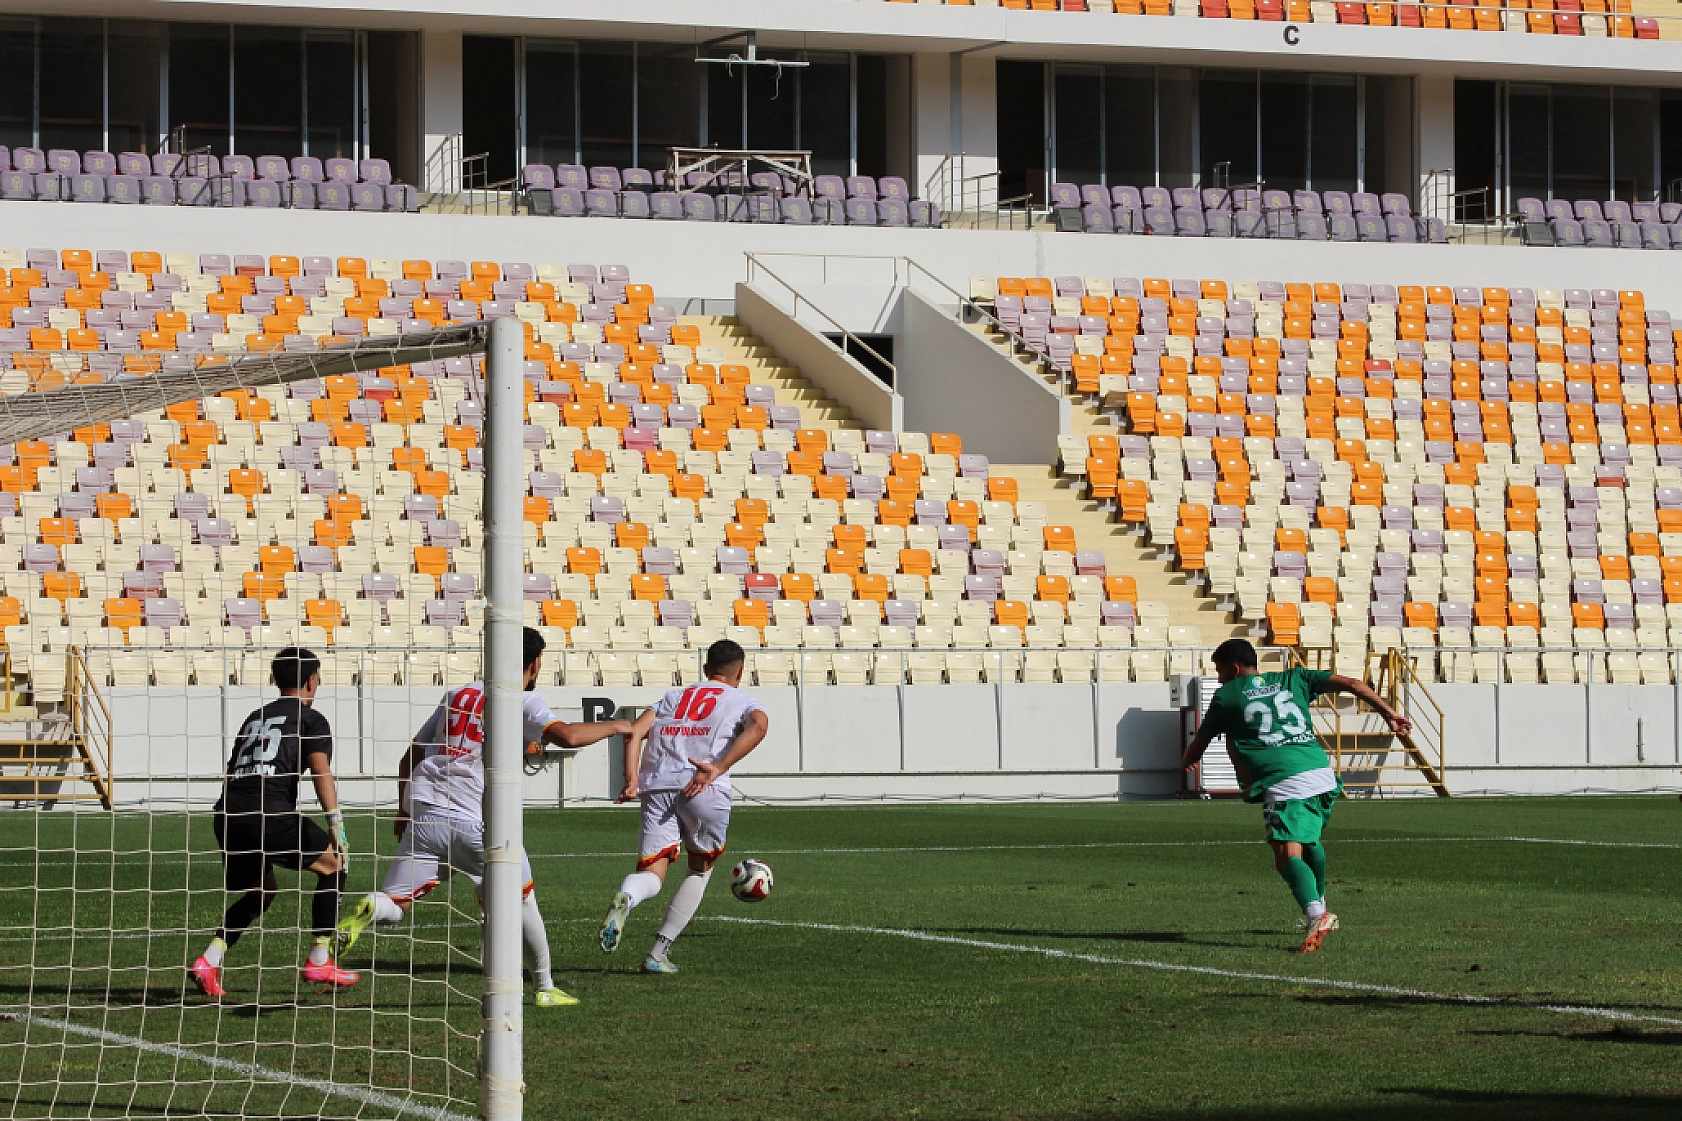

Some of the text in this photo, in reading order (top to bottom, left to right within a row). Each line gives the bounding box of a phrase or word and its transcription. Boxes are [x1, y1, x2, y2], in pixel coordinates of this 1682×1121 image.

[1283, 25, 1300, 46] C
[674, 686, 724, 721] 16
[1243, 690, 1307, 742] 25
[236, 715, 288, 766] 25
